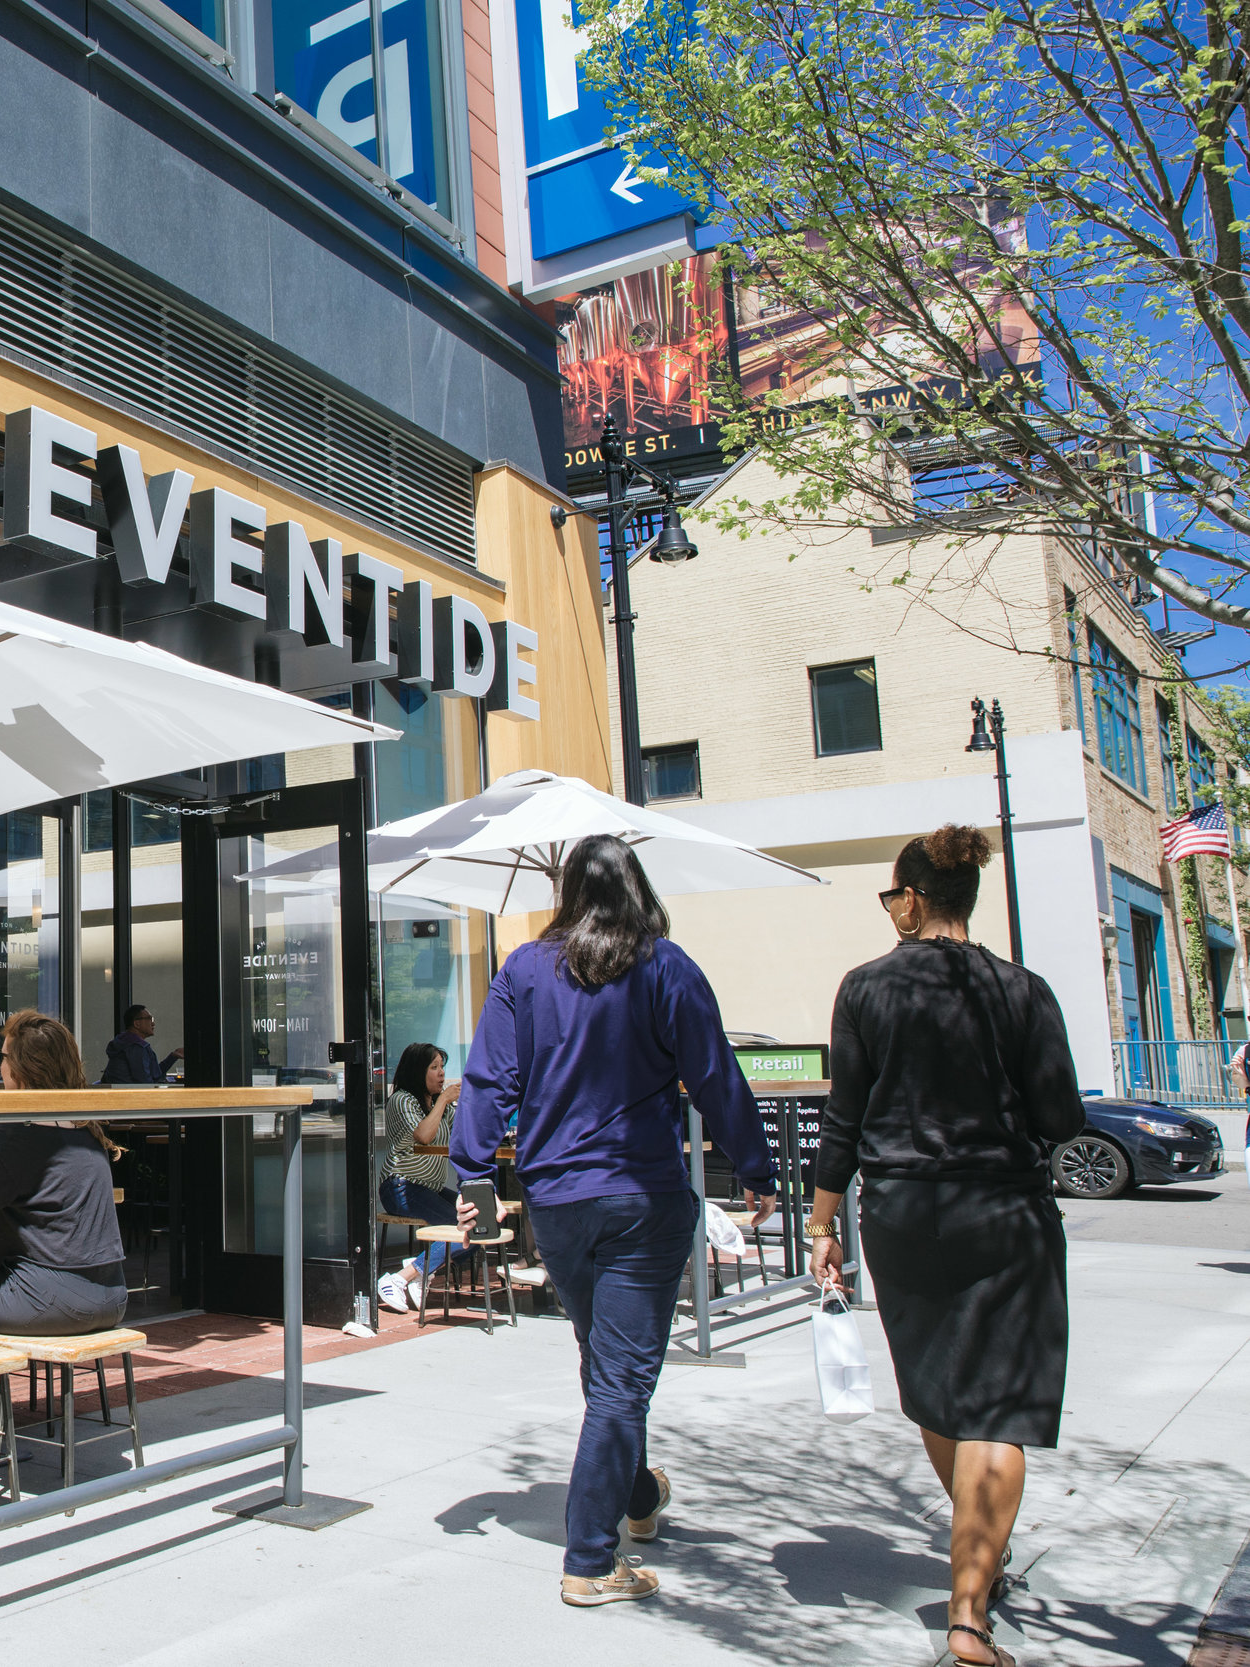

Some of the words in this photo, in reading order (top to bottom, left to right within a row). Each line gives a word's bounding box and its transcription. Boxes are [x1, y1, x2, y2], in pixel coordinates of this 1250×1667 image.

[565, 440, 637, 468] DOWE
[645, 434, 676, 453] ST.
[28, 405, 541, 722] EVENTIDE
[752, 1056, 803, 1071] Retail
